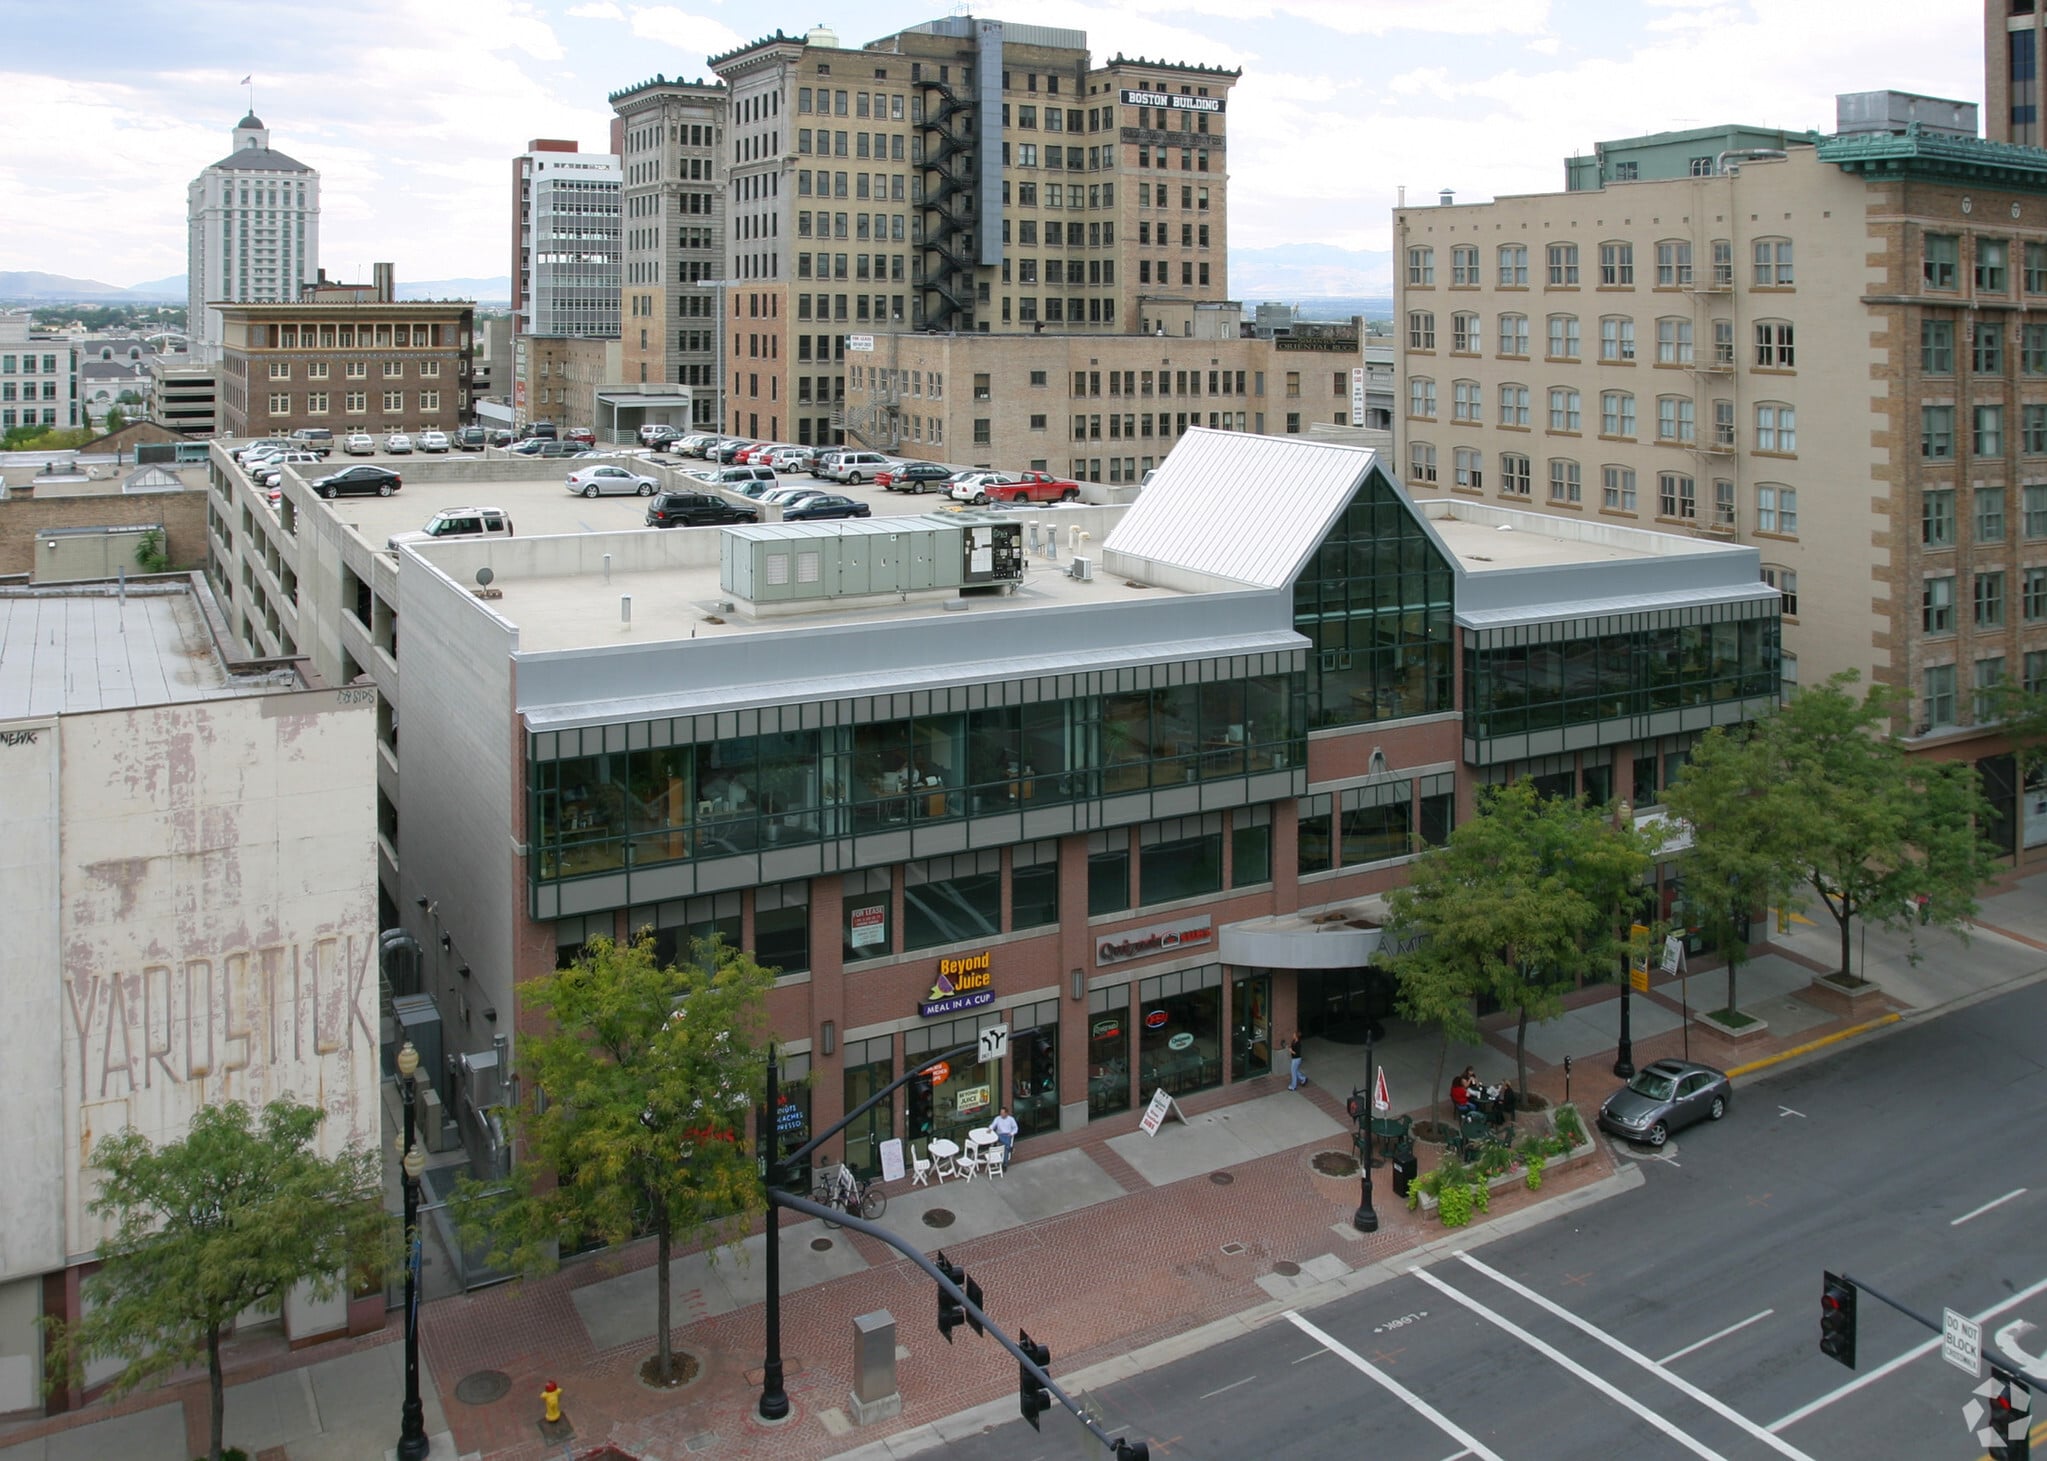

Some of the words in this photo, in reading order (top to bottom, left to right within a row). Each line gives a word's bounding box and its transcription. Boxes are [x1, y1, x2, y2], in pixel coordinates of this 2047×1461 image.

[1128, 92, 1168, 106] BOSTON
[1172, 96, 1219, 111] BUILDING
[1278, 343, 1331, 352] ORIENTAL
[1332, 344, 1357, 353] RUGS
[852, 908, 865, 918] FOR
[941, 951, 990, 975] Beyond
[955, 972, 990, 991] Juice
[926, 1002, 950, 1015] MEAL
[952, 999, 962, 1009] IN
[965, 997, 972, 1006] A
[974, 993, 991, 1004] CUP
[66, 932, 375, 1100] YARDSTICK
[959, 1089, 978, 1098] BEYOND
[961, 1095, 977, 1105] JUICE
[1947, 1315, 1958, 1330] DO
[1962, 1322, 1977, 1340] NOT
[1946, 1332, 1977, 1358] BLOCK
